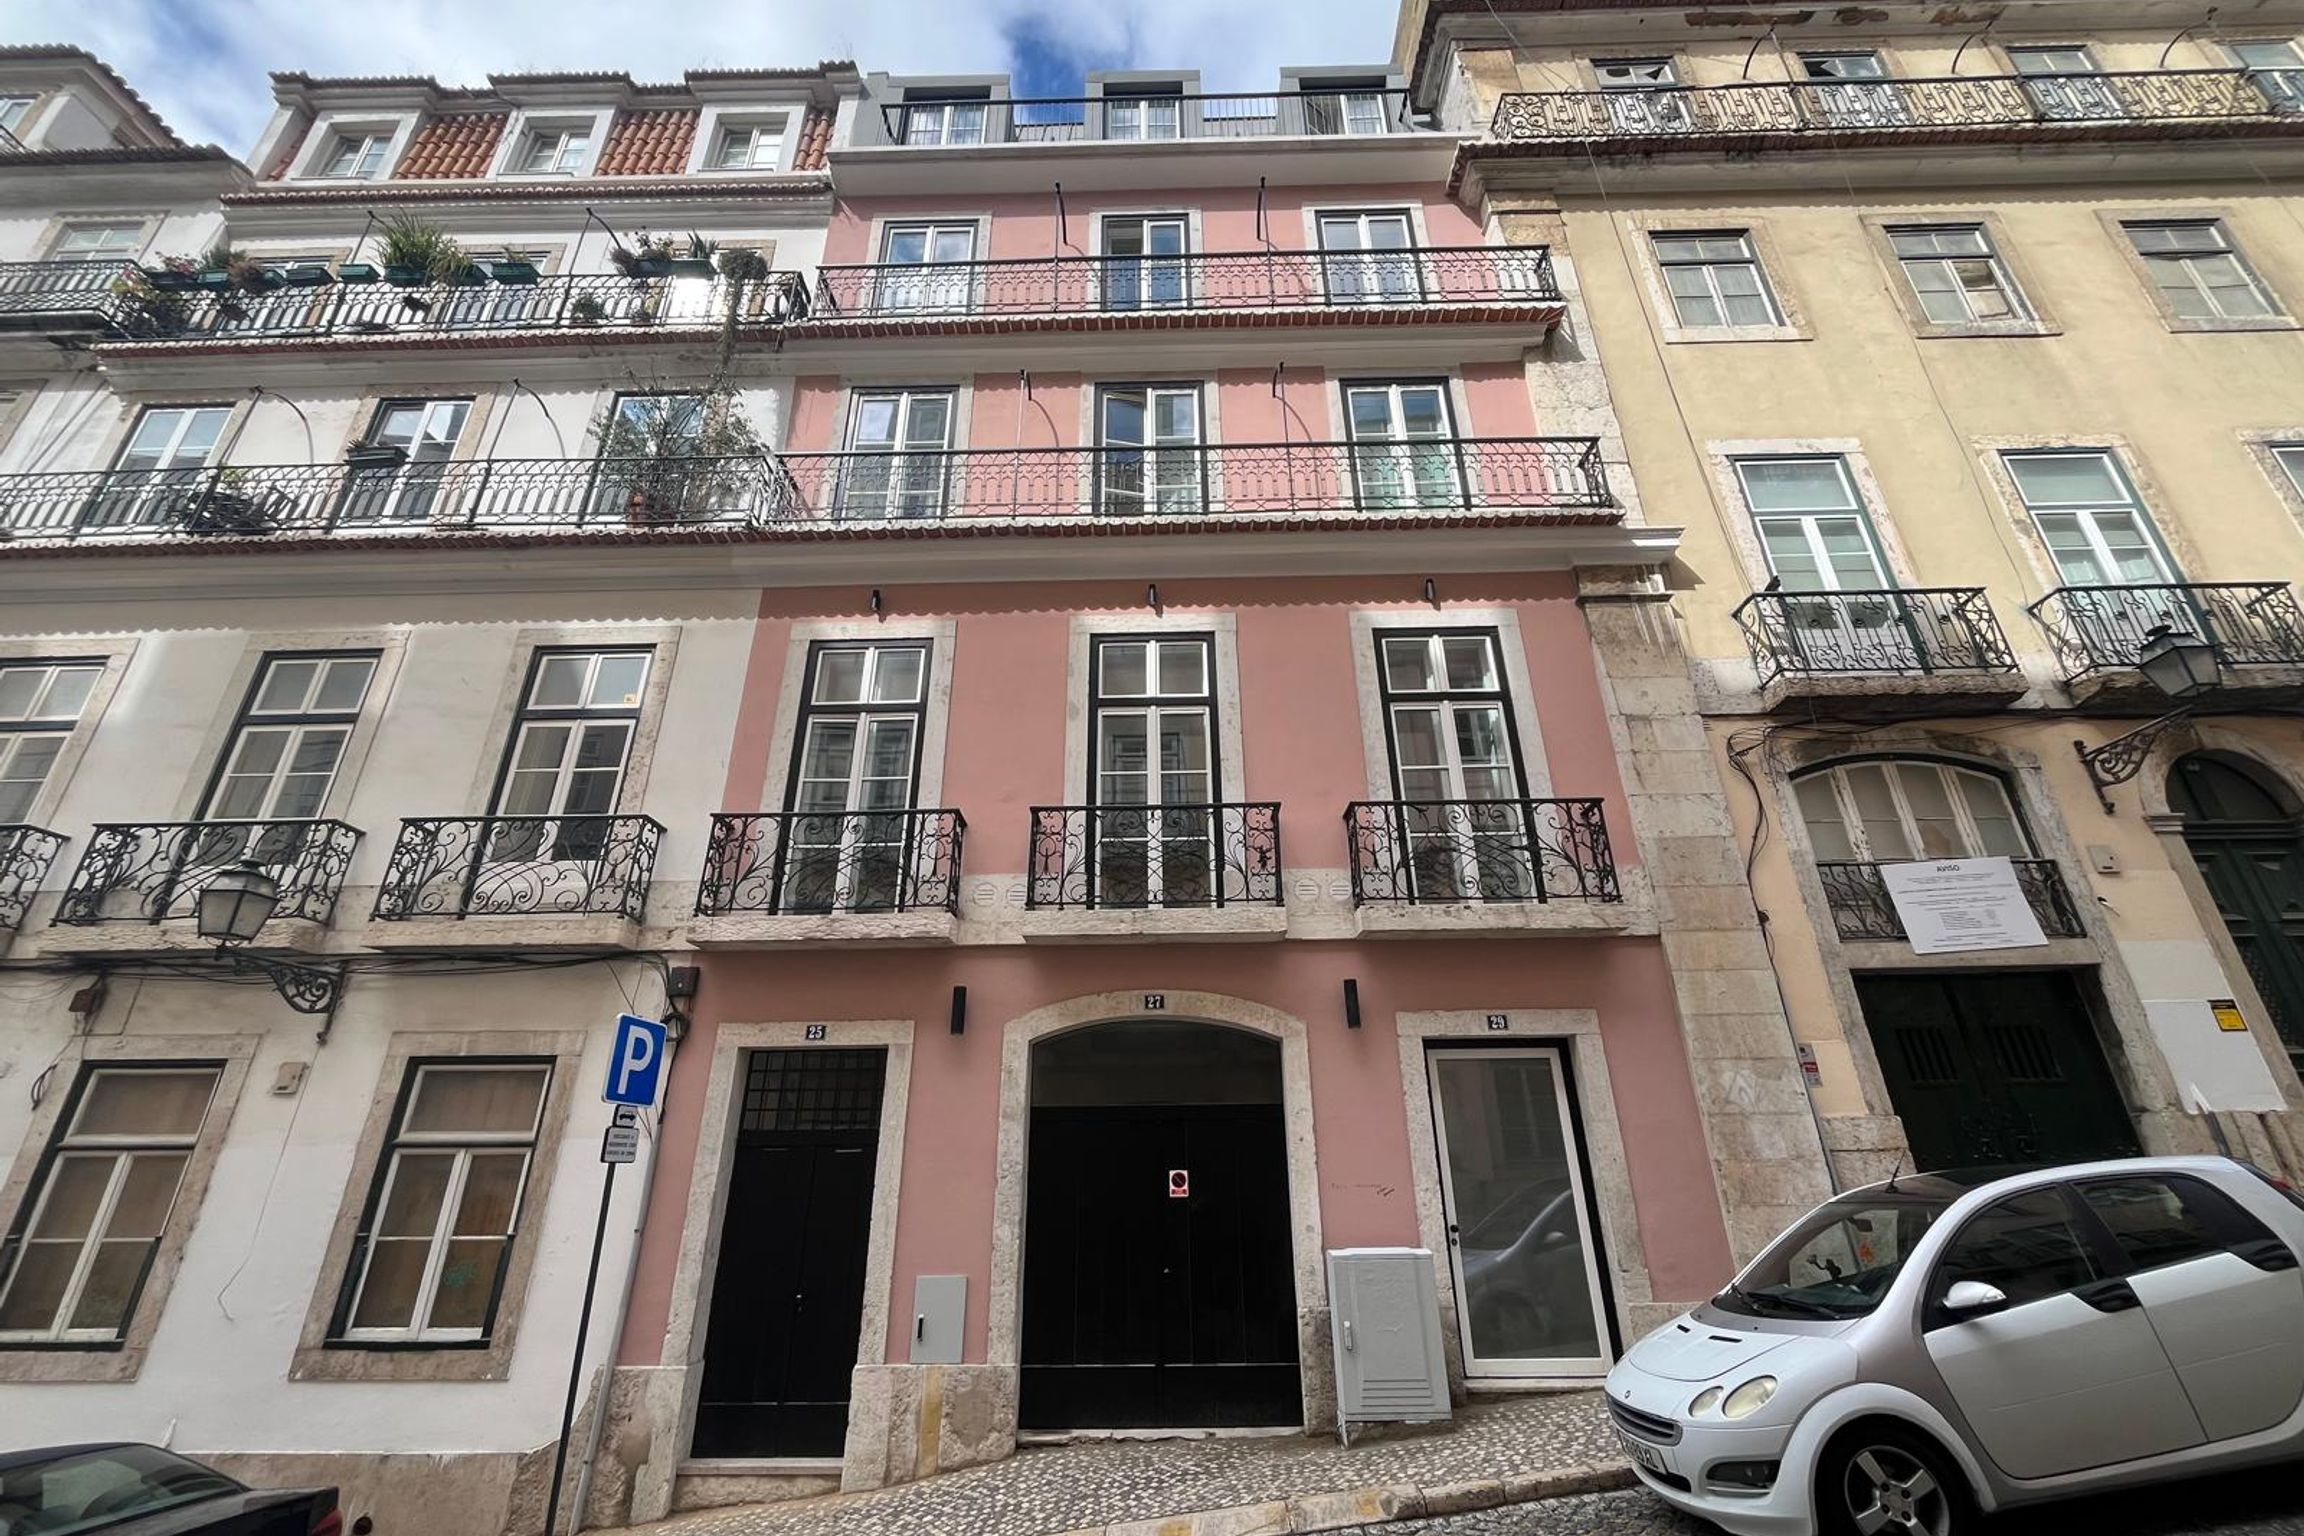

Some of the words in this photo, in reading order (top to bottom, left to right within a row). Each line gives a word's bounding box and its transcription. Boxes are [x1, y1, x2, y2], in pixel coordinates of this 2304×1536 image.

[1147, 995, 1161, 1009] 27
[1490, 1015, 1505, 1029] 29
[808, 1025, 822, 1039] 25
[617, 1025, 654, 1094] P
